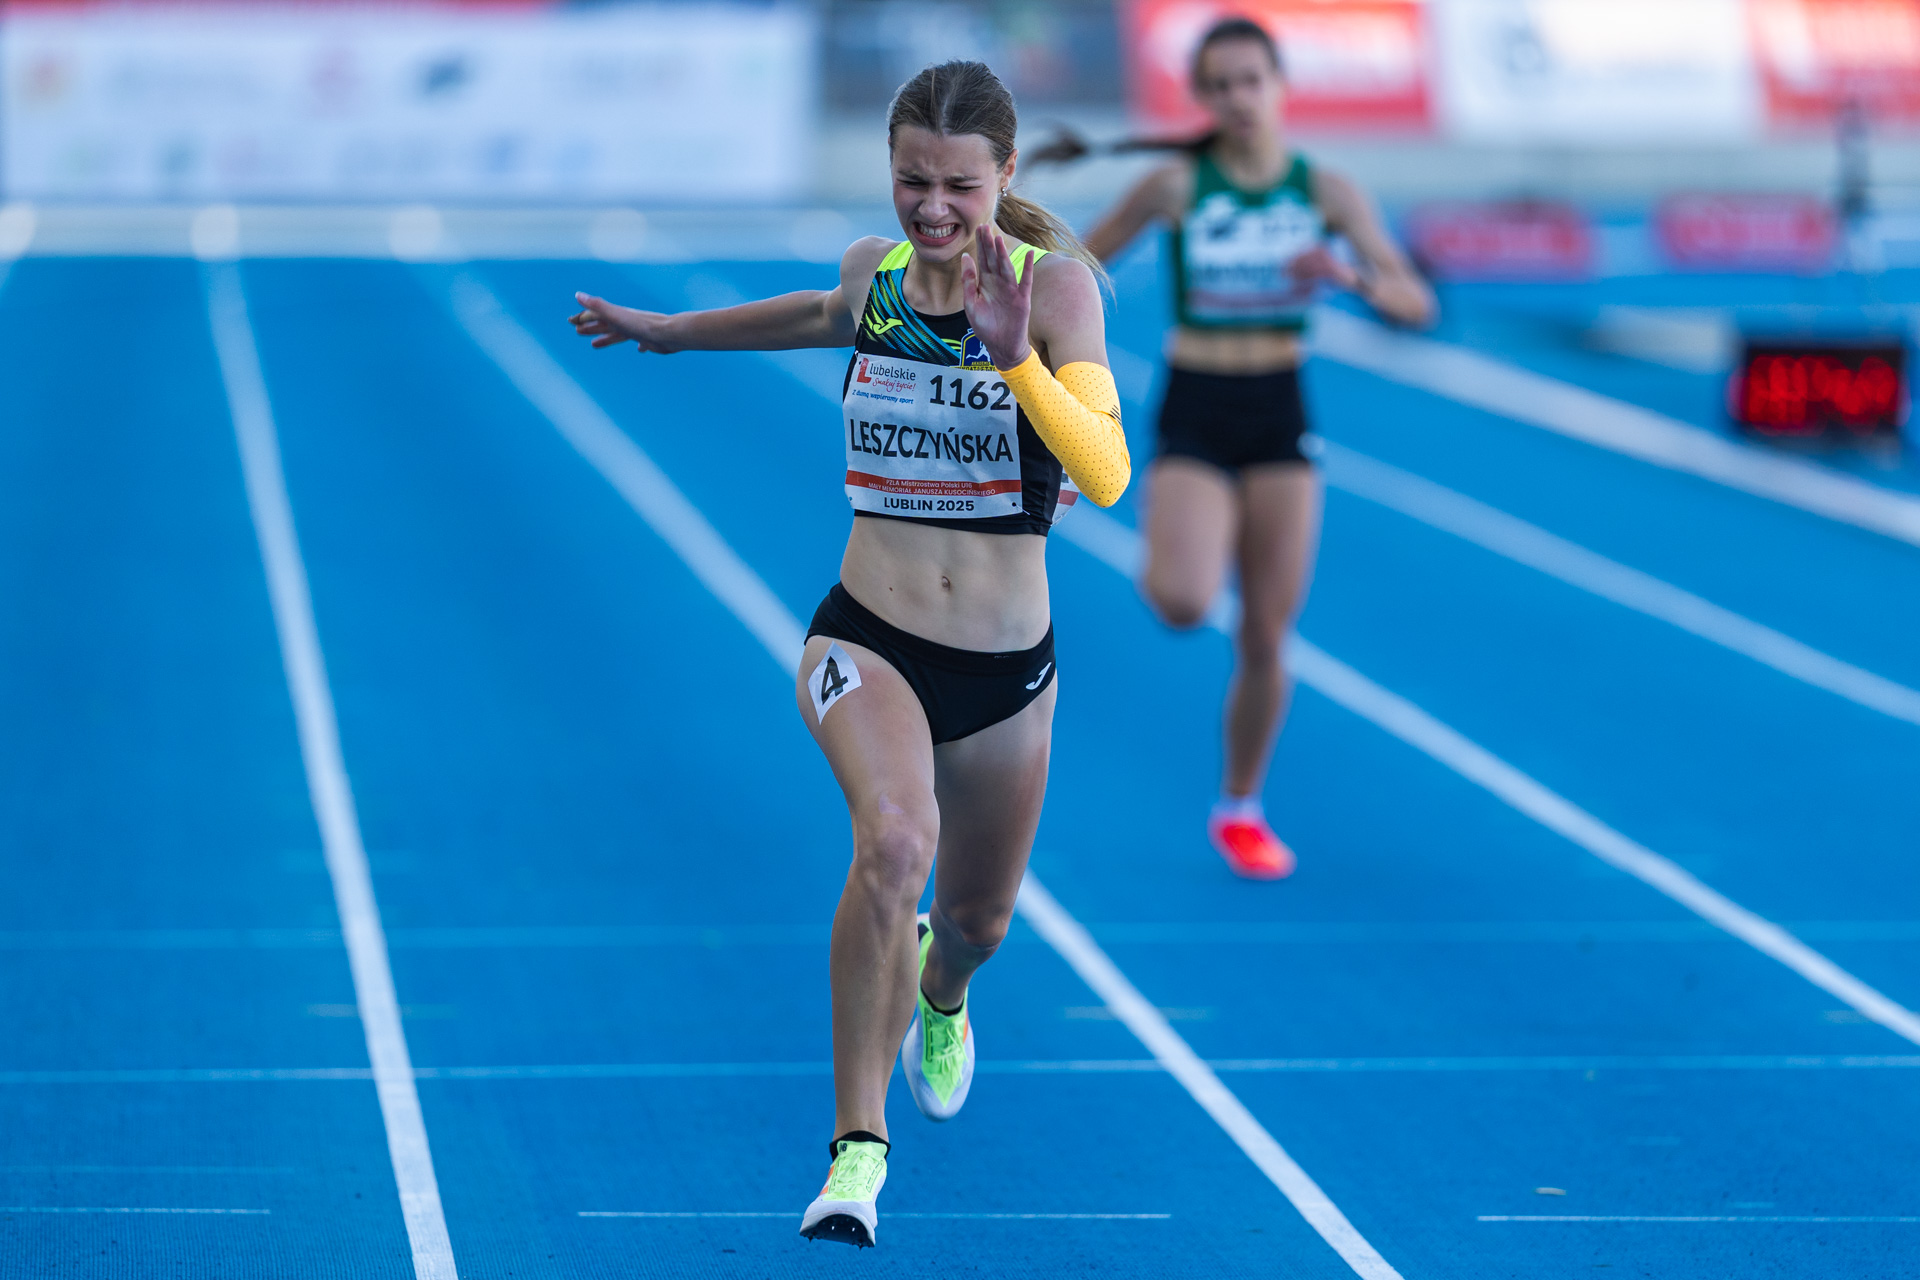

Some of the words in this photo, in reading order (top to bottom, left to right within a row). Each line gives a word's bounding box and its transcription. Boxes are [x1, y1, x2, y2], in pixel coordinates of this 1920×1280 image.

[869, 363, 916, 381] lubelskie
[872, 377, 895, 393] Smakuj
[895, 380, 917, 392] życie!
[929, 374, 1011, 410] 1162
[870, 393, 899, 403] wspieramy
[899, 397, 914, 405] sport
[850, 418, 1014, 464] LESZCZYŃSKA
[868, 481, 881, 491] MAŁY
[882, 484, 912, 494] MEMORIAŁ
[913, 487, 942, 495] JANUSZA
[944, 487, 996, 497] KUSOCIŃSKIEGO
[886, 479, 900, 487] PZLA
[901, 480, 940, 488] Mistrzostwa
[941, 481, 960, 489] Polski
[884, 496, 932, 511] LUBLIN
[937, 500, 975, 512] 2025
[821, 655, 849, 706] 4
